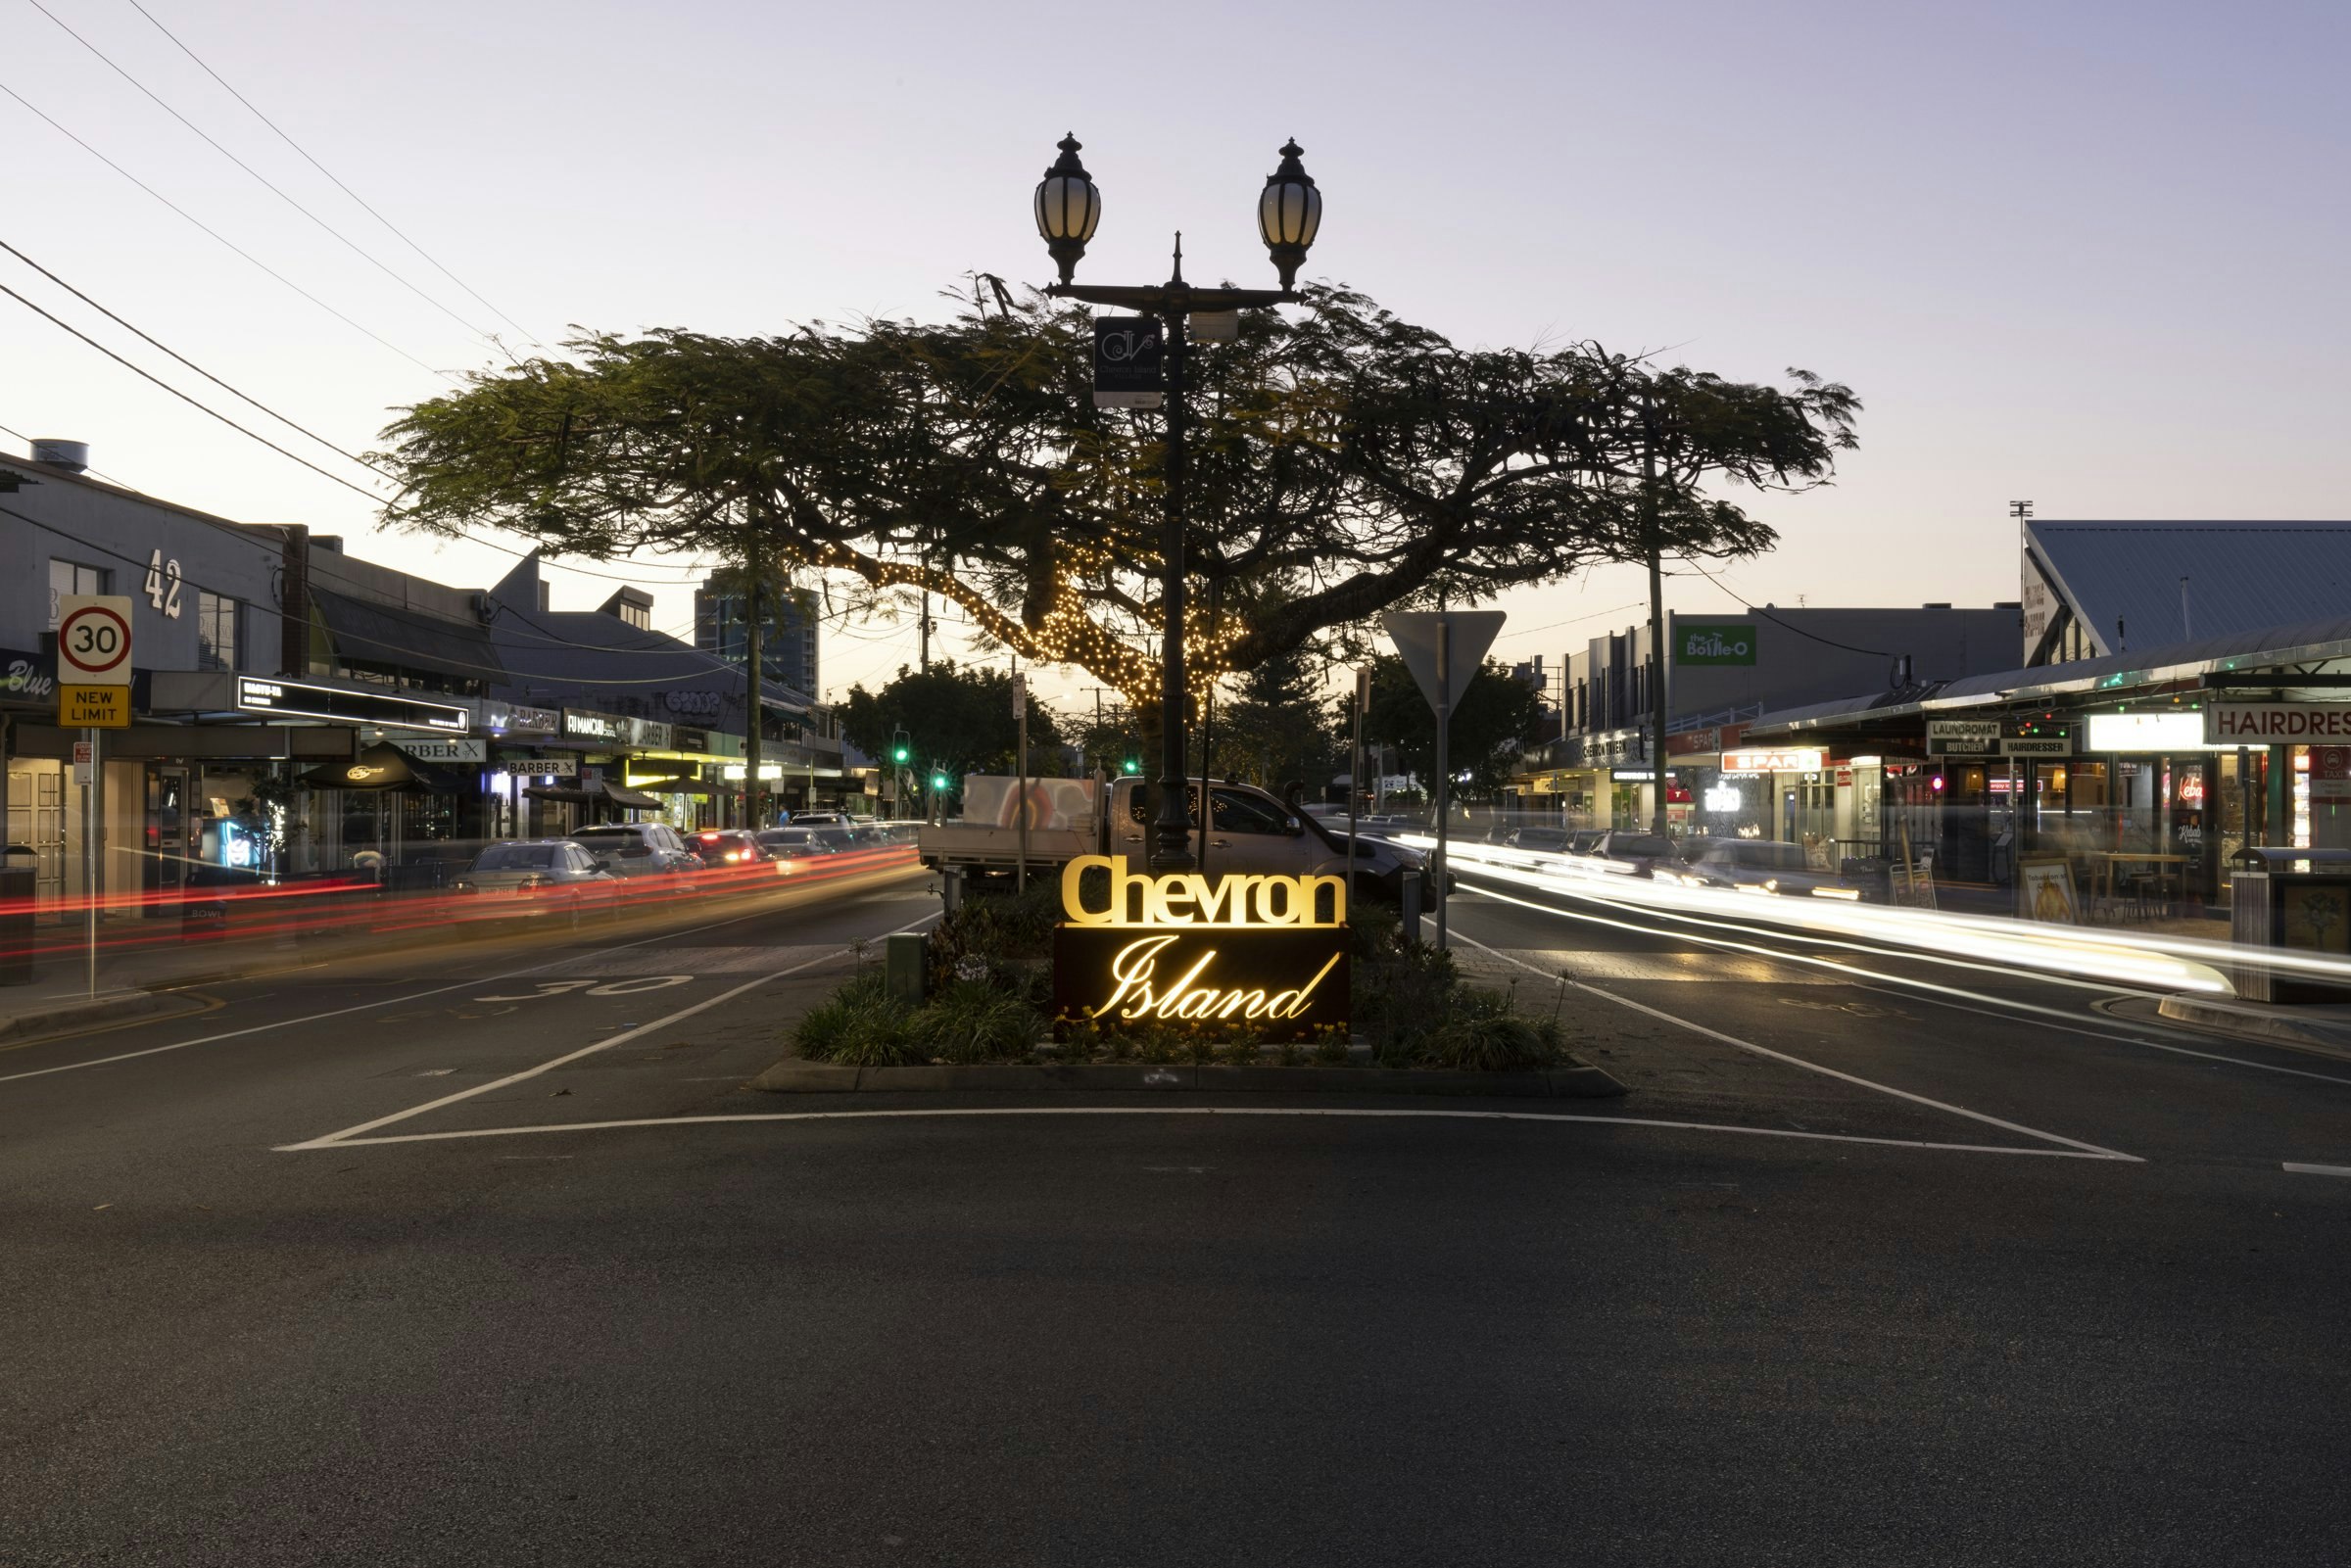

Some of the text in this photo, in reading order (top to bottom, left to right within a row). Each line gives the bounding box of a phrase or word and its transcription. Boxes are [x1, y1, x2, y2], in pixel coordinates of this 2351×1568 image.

[145, 548, 181, 620] 42
[74, 625, 118, 654] 30
[8, 659, 52, 696] Blue
[75, 691, 113, 704] NEW
[72, 708, 117, 721] LIMIT
[519, 709, 557, 732] BARBER
[568, 715, 577, 733] FU
[577, 716, 604, 736] MANCHU
[639, 723, 663, 745] ARBER
[1933, 724, 1997, 736] LAUNDROMAT
[1583, 739, 1627, 758] CHEVRON TAVERN
[1693, 735, 1714, 749] SPAR
[1946, 741, 1985, 752] BUTCHER
[2007, 742, 2064, 752] HAIRDRESSER
[509, 762, 559, 774] BARBER
[1737, 755, 1799, 769] SPAR
[2325, 770, 2343, 779] TAXI
[1062, 854, 1347, 926] Chevron
[1092, 934, 1344, 1019] Island
[473, 974, 694, 1002] 30
